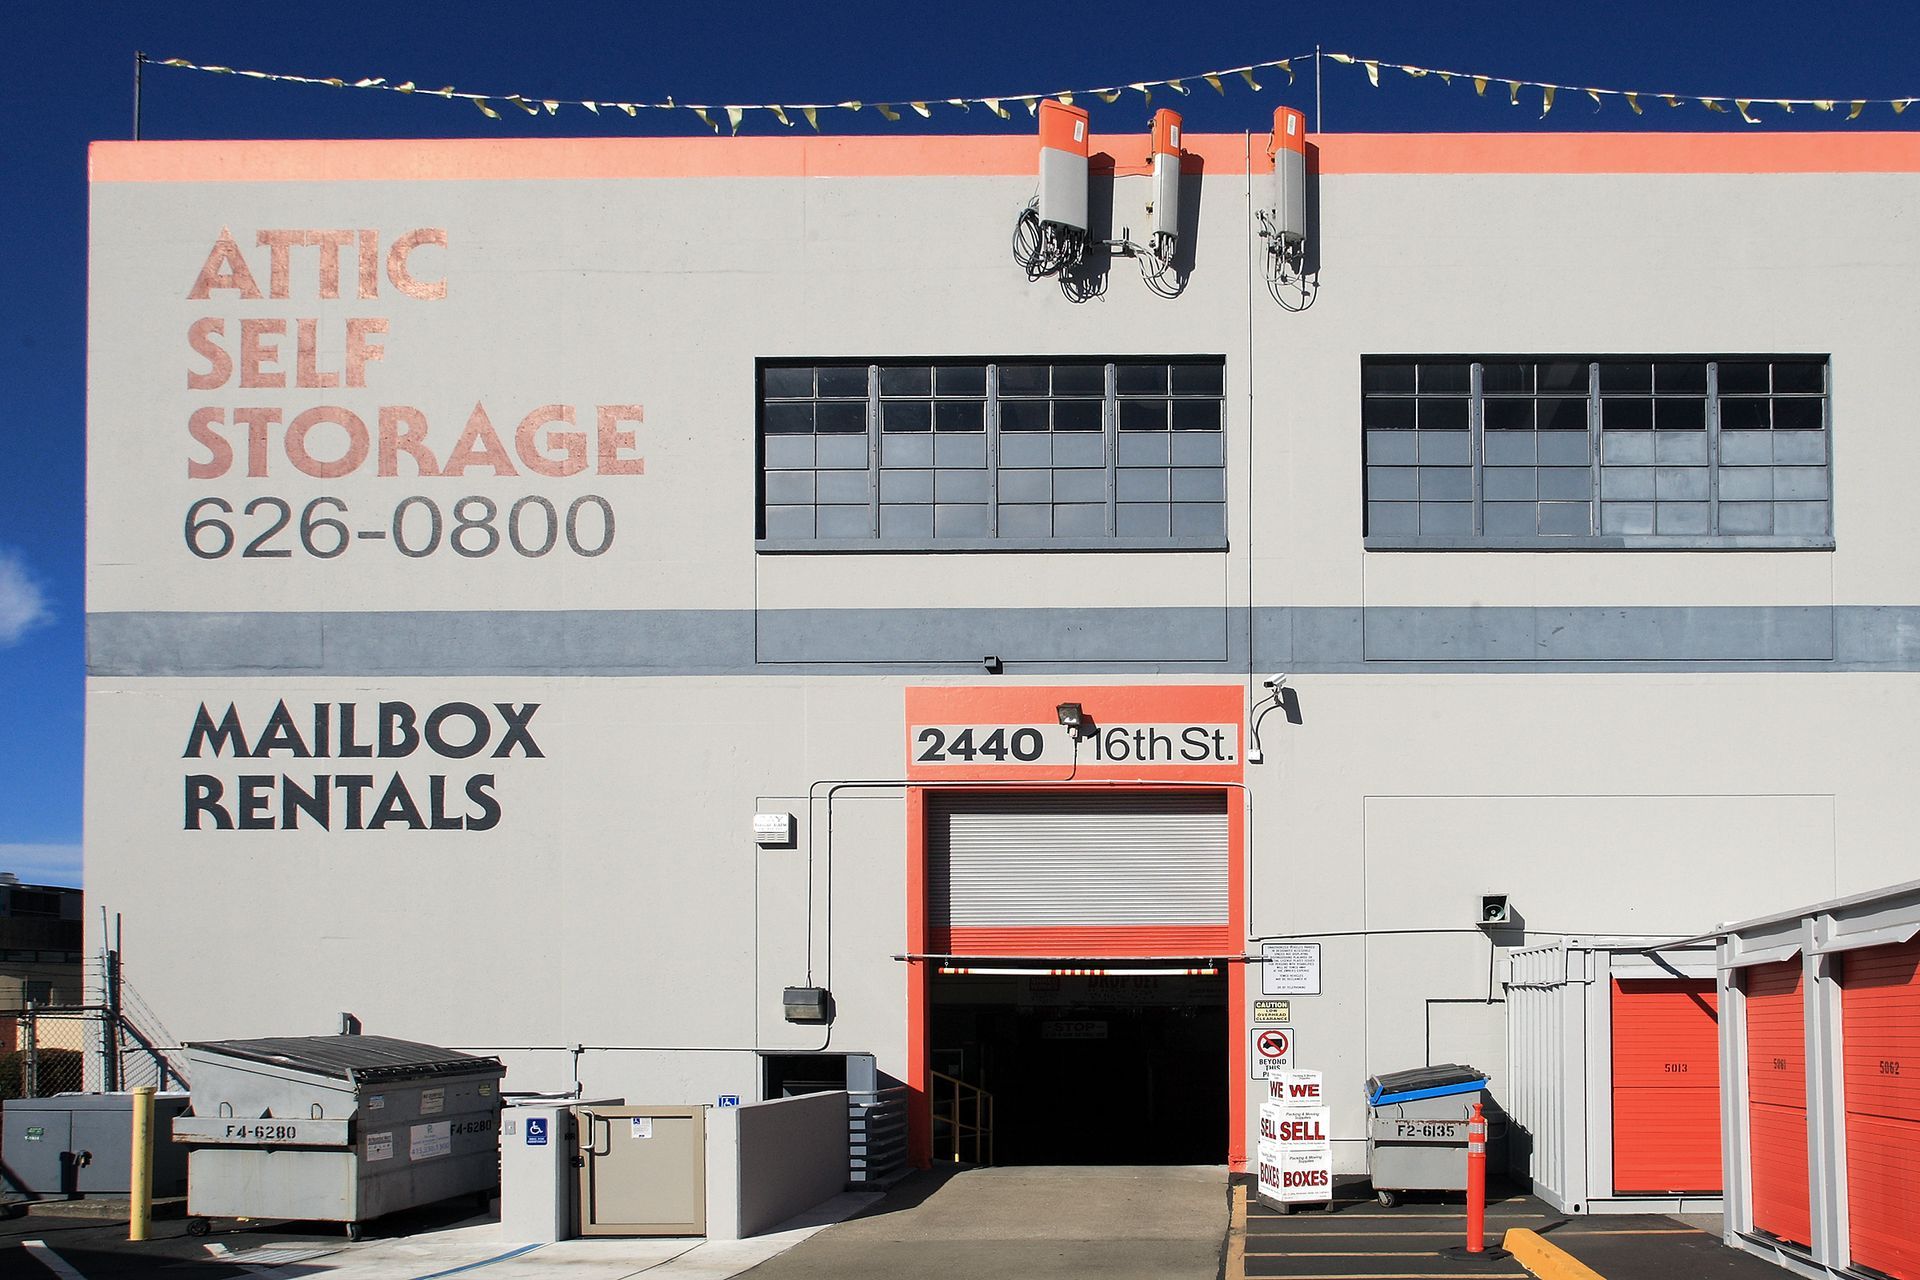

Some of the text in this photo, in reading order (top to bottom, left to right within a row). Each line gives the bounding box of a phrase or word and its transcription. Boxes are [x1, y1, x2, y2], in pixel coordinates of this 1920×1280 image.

[185, 225, 448, 301] ATTIC
[186, 317, 390, 391] SELF
[186, 401, 645, 480] STORAGE
[184, 494, 616, 560] 626-0800
[182, 698, 546, 759] MAILBOX
[917, 727, 1235, 762] 2440 16th St.
[183, 770, 502, 832] RENTALS
[1053, 1022, 1096, 1032] STOP
[1664, 1063, 1688, 1073] 5013
[1879, 1060, 1900, 1075] 5062
[1269, 1080, 1284, 1099] WE
[1289, 1084, 1320, 1097] WE
[225, 1124, 297, 1140] F4-6280
[450, 1119, 492, 1136] F4-6280
[1260, 1117, 1277, 1140] SELL
[1279, 1121, 1325, 1141] SELL
[1397, 1124, 1455, 1138] F2-6135
[1260, 1161, 1280, 1189] BOXES
[1283, 1170, 1329, 1188] BOXES
